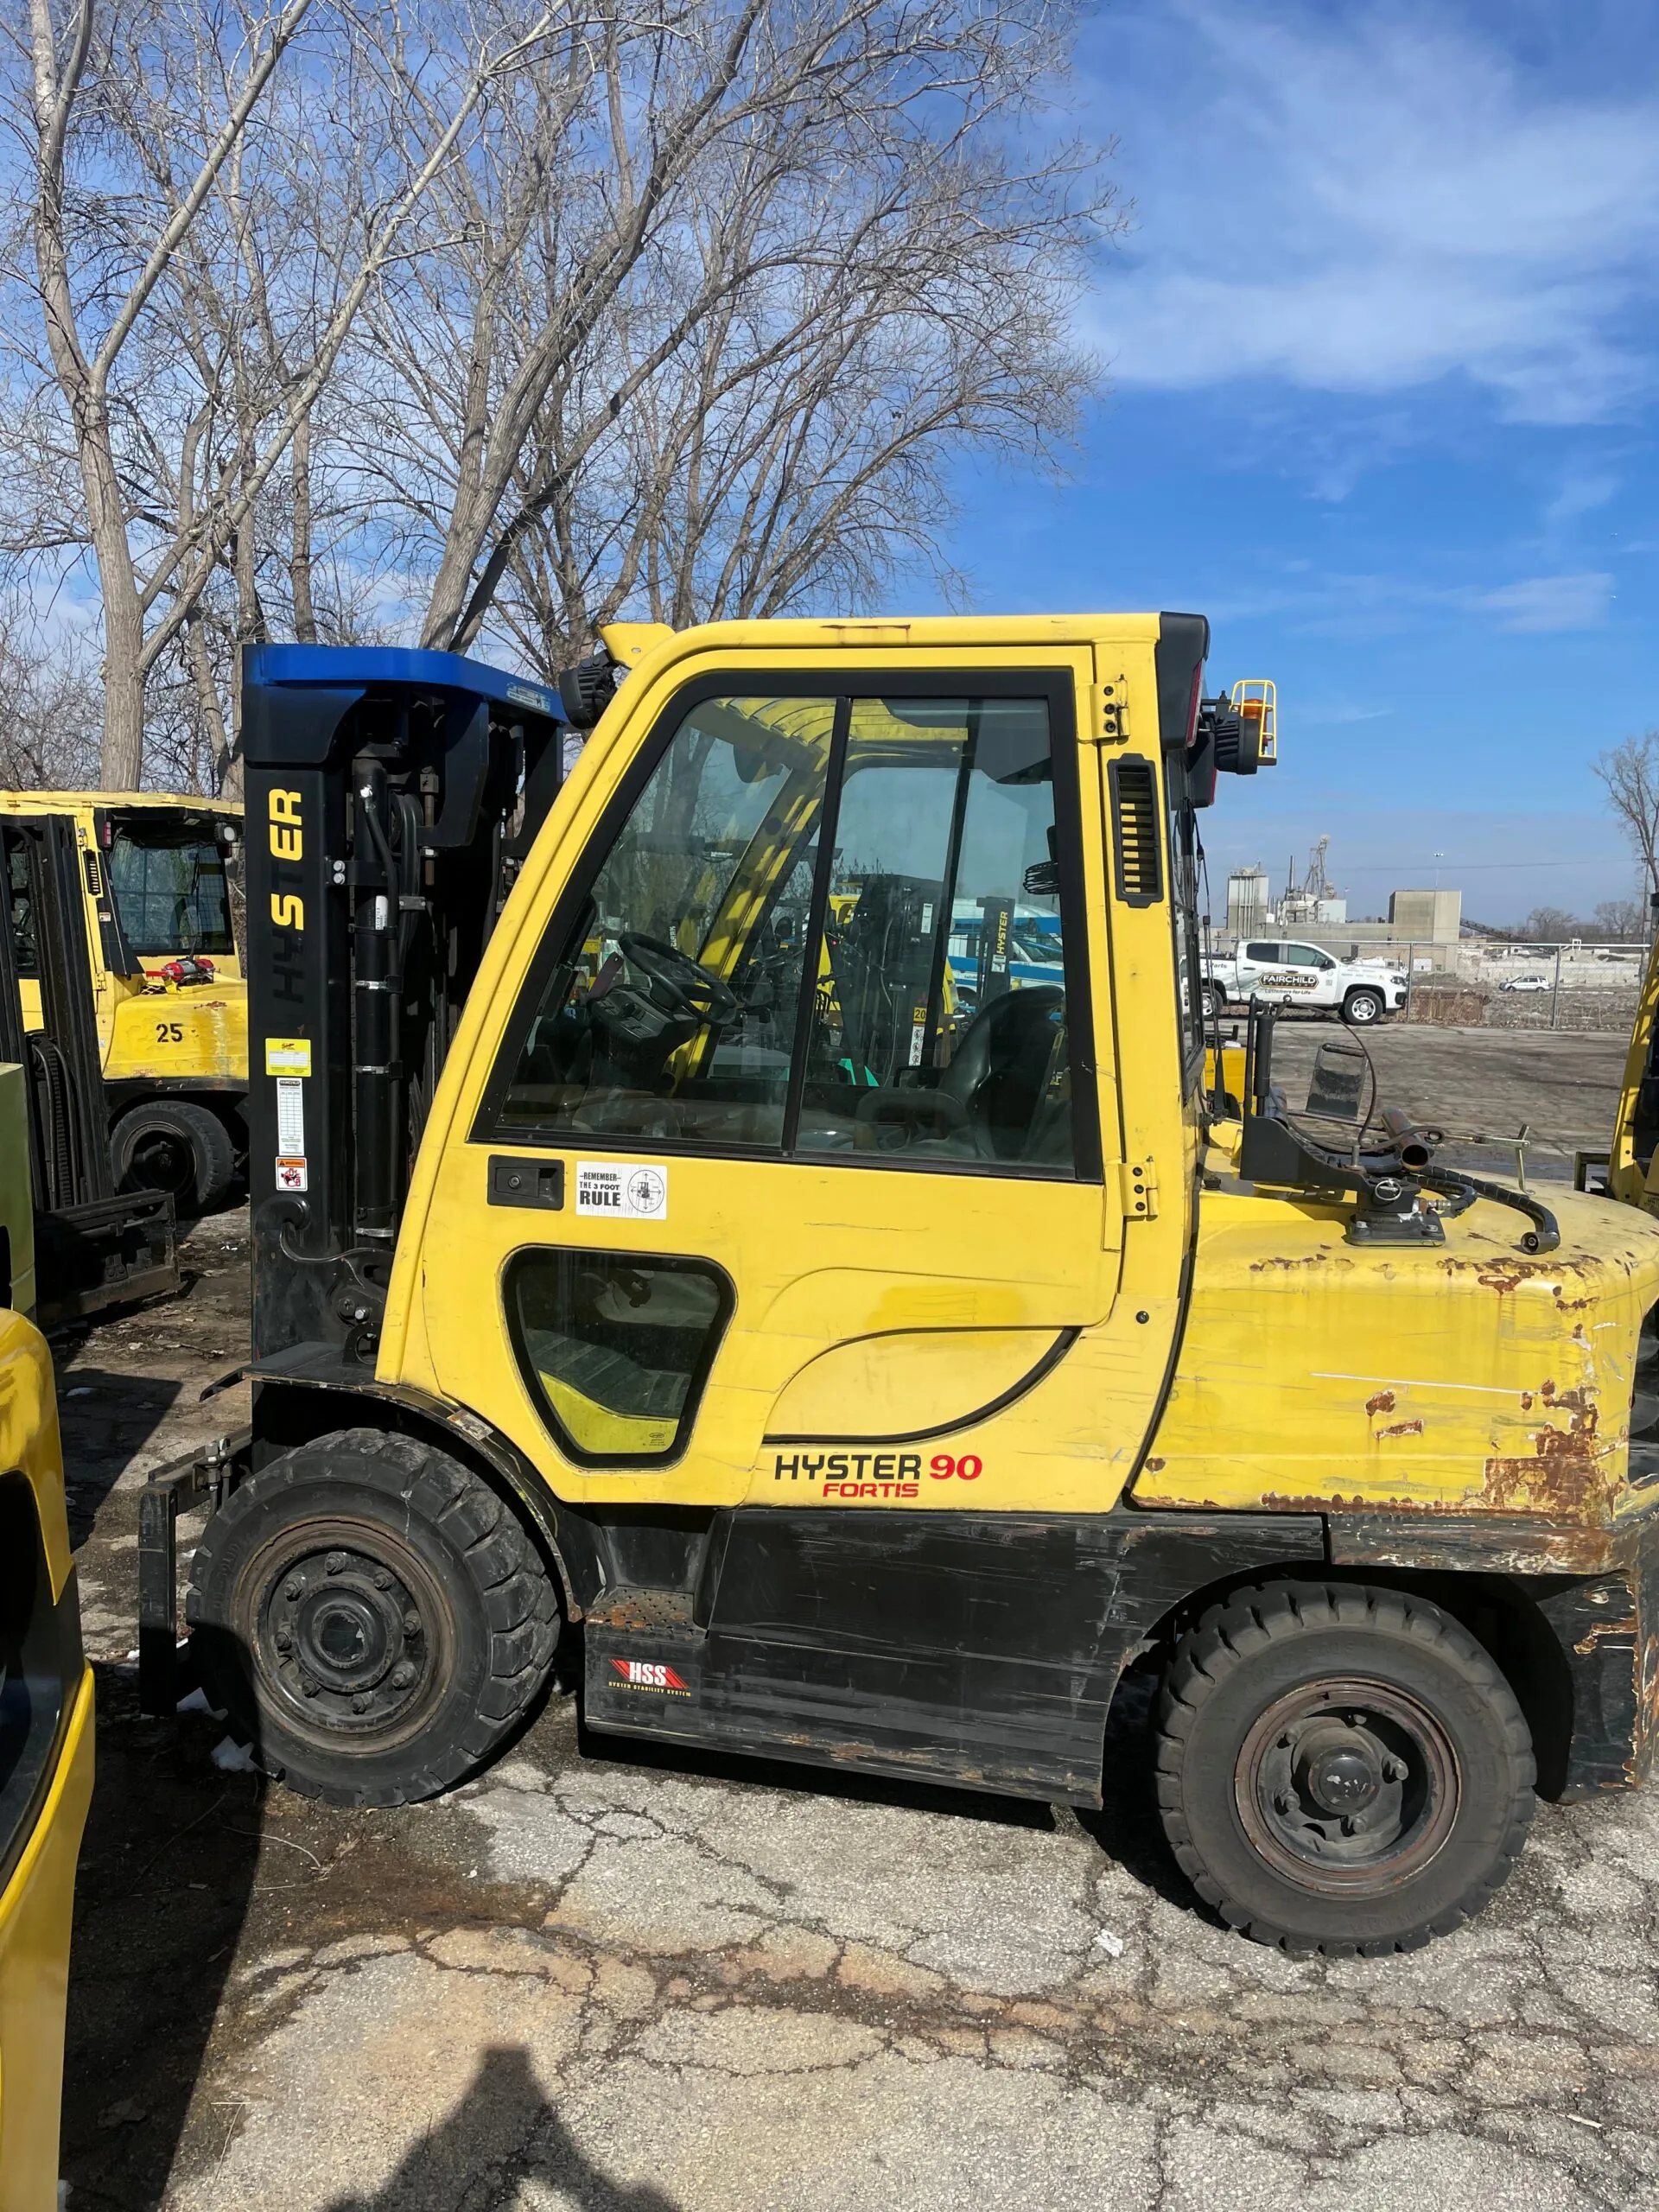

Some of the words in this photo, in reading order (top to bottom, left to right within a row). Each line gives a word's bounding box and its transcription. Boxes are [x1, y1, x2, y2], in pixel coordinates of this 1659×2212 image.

[996, 911, 1008, 954] HYSTER
[1263, 976, 1316, 984] FAIRCHILD
[914, 1009, 926, 1019] 20
[156, 1023, 183, 1044] 25
[580, 1191, 621, 1206] RULE
[774, 1453, 922, 1481] HYSTER
[929, 1454, 983, 1481] 90
[823, 1483, 919, 1498] FORTIS
[629, 1661, 667, 1687] HSS
[632, 1684, 664, 1694] STABILITY
